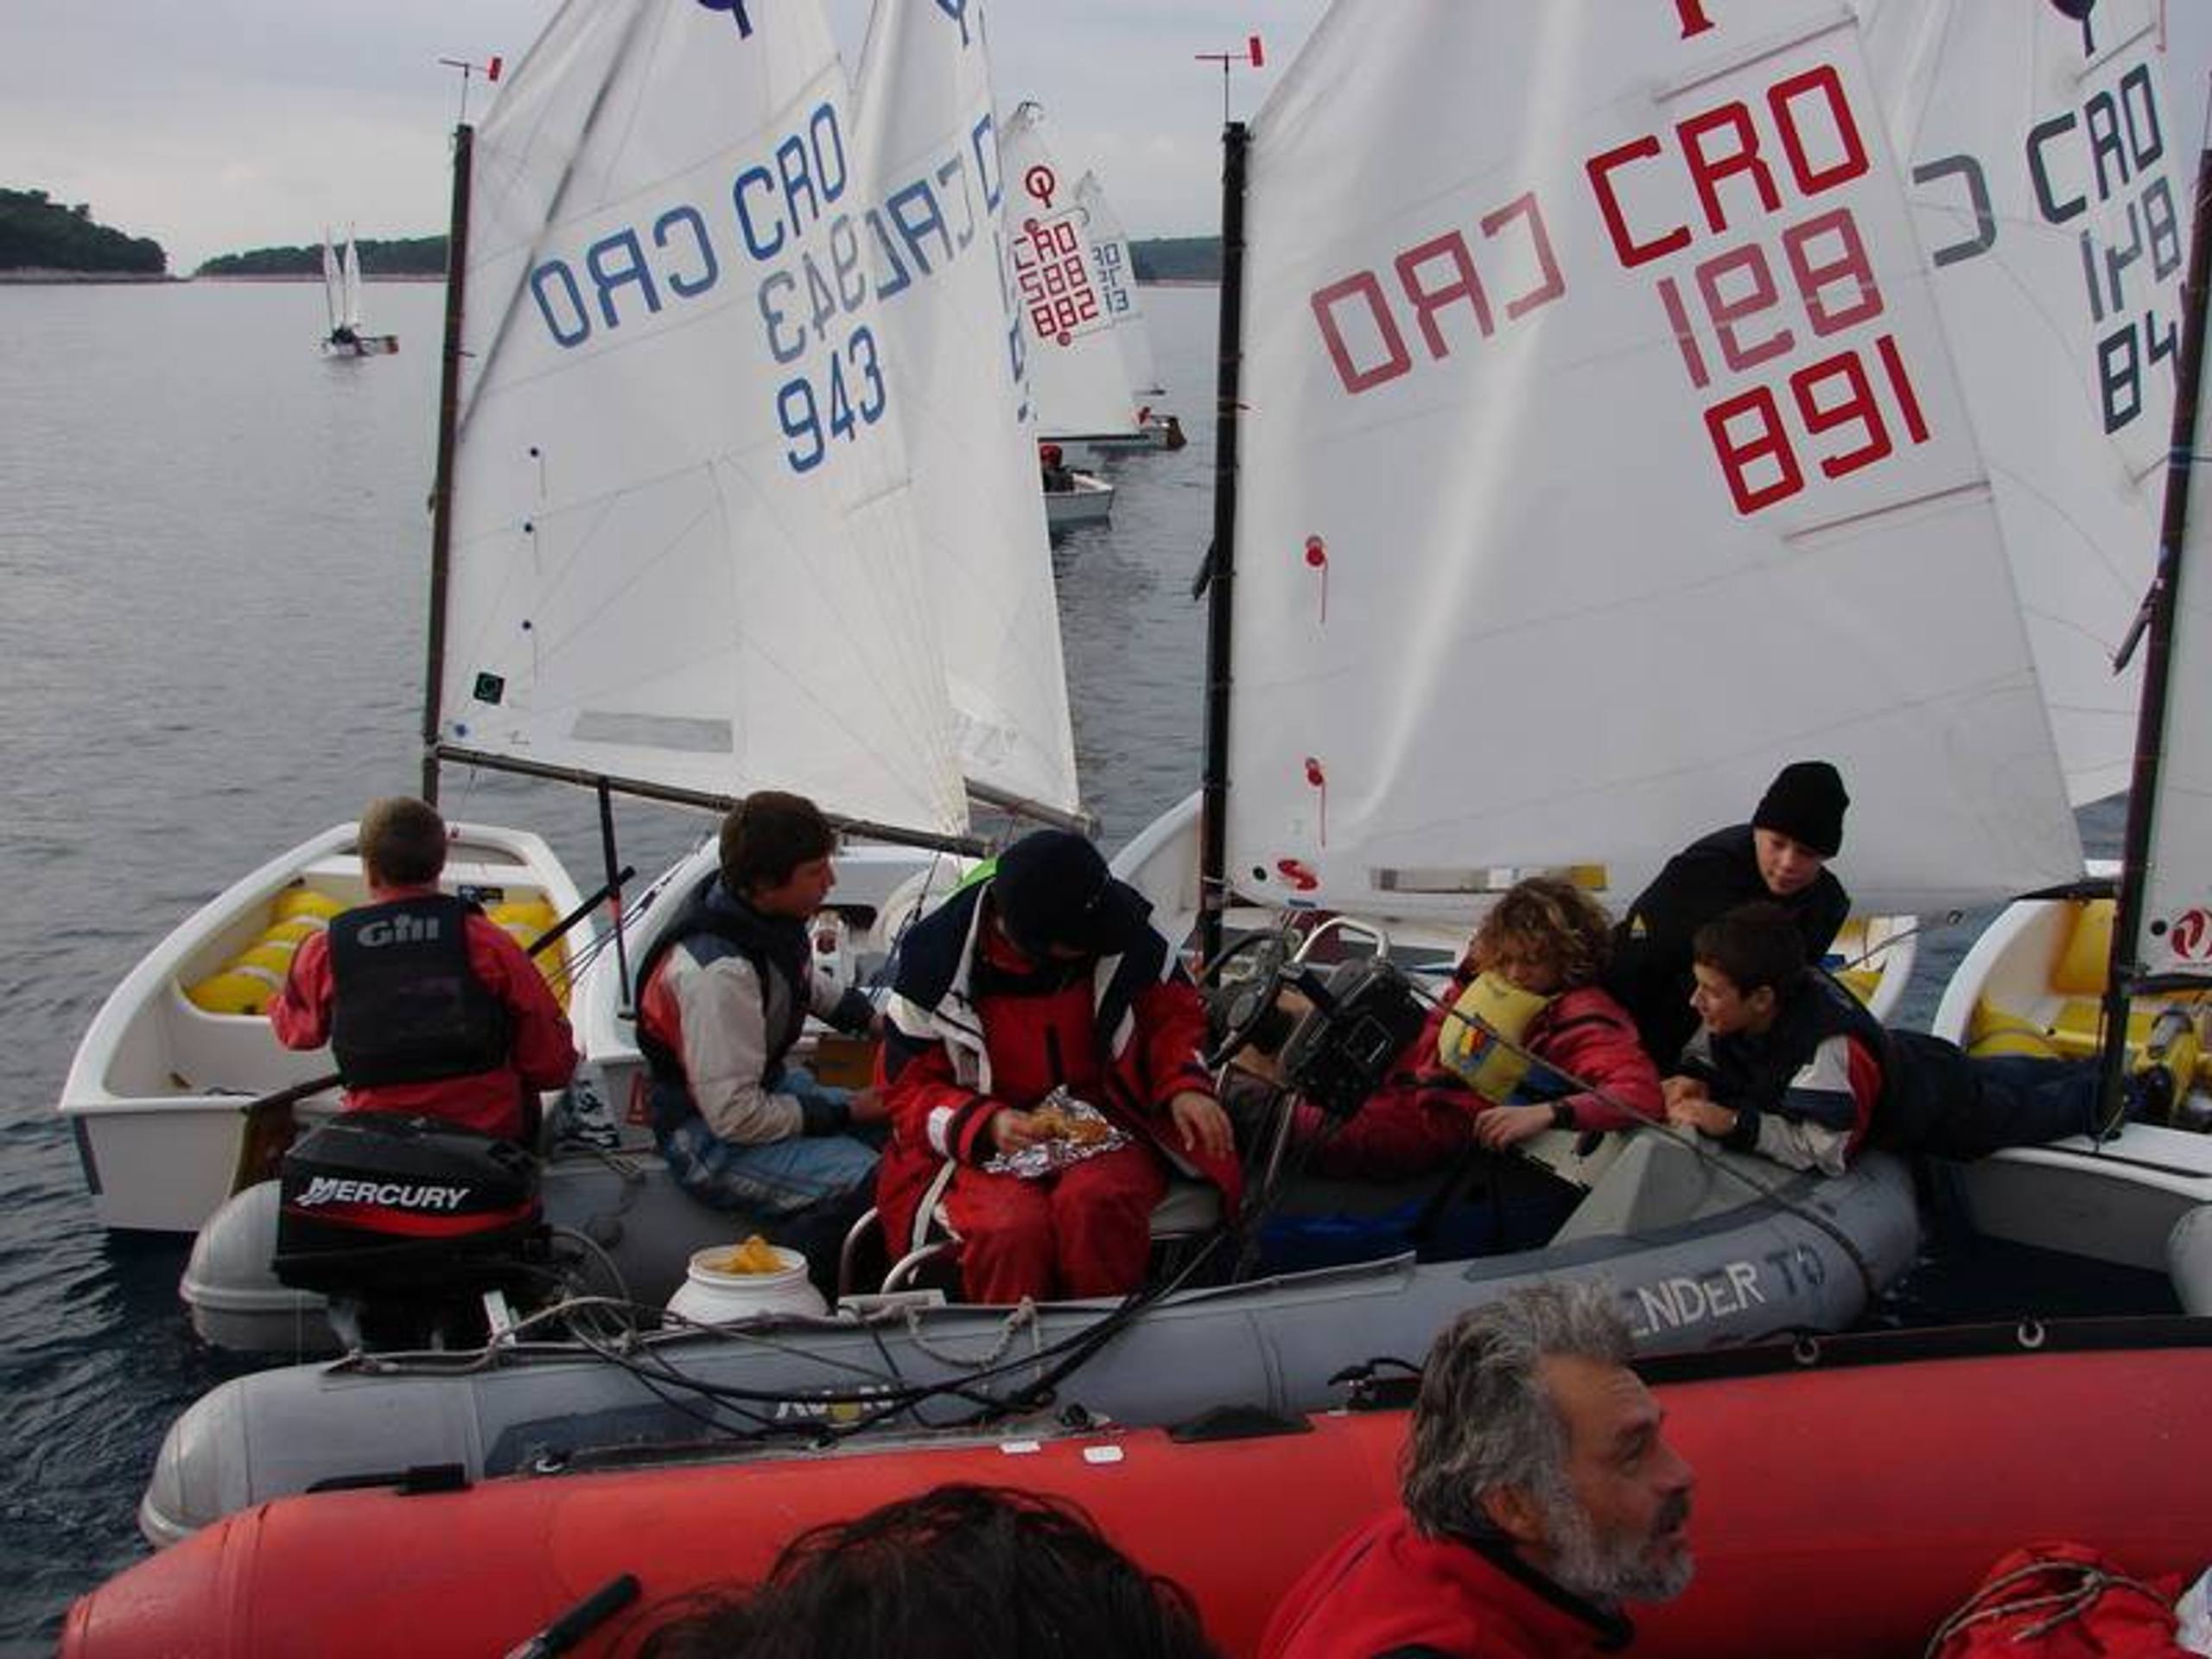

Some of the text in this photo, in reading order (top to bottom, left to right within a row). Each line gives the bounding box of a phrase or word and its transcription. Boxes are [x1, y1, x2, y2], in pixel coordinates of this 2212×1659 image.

[733, 102, 848, 261] CRO
[1586, 64, 1870, 268] CRO
[2026, 63, 2163, 225] CRO
[778, 326, 887, 474] 943
[1703, 334, 1930, 515] 891
[2097, 282, 2187, 435] 84
[357, 913, 439, 947] Gill
[296, 1176, 470, 1209] MERCURY
